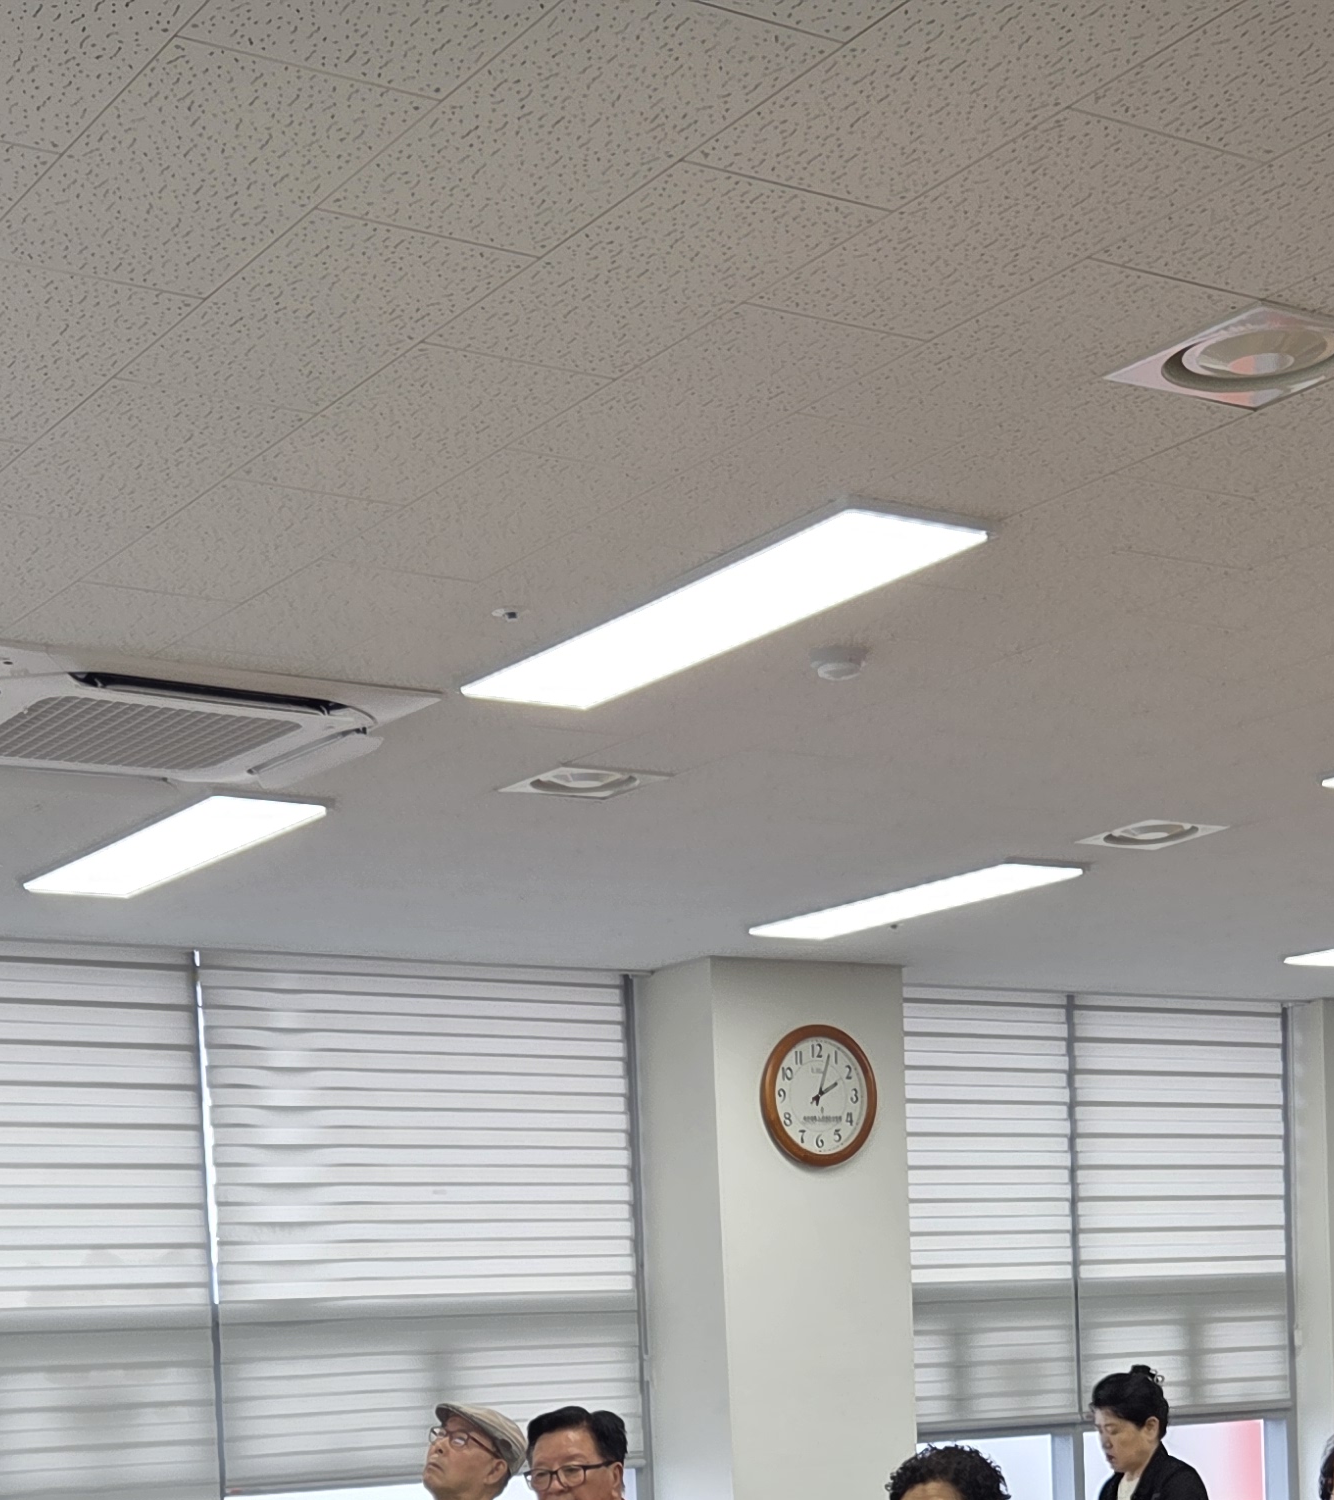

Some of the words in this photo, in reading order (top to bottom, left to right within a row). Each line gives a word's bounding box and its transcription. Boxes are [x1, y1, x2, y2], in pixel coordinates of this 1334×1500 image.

[795, 1051, 803, 1065] 11
[811, 1043, 823, 1058] 12
[834, 1050, 839, 1065] 1
[782, 1067, 793, 1081] 10
[845, 1065, 852, 1080] 2
[777, 1088, 786, 1103] 9
[850, 1088, 859, 1104] 3
[783, 1112, 793, 1127] 8
[845, 1112, 853, 1126] 4
[798, 1129, 806, 1144] 7
[816, 1134, 824, 1149] 6
[834, 1129, 842, 1142] 5
